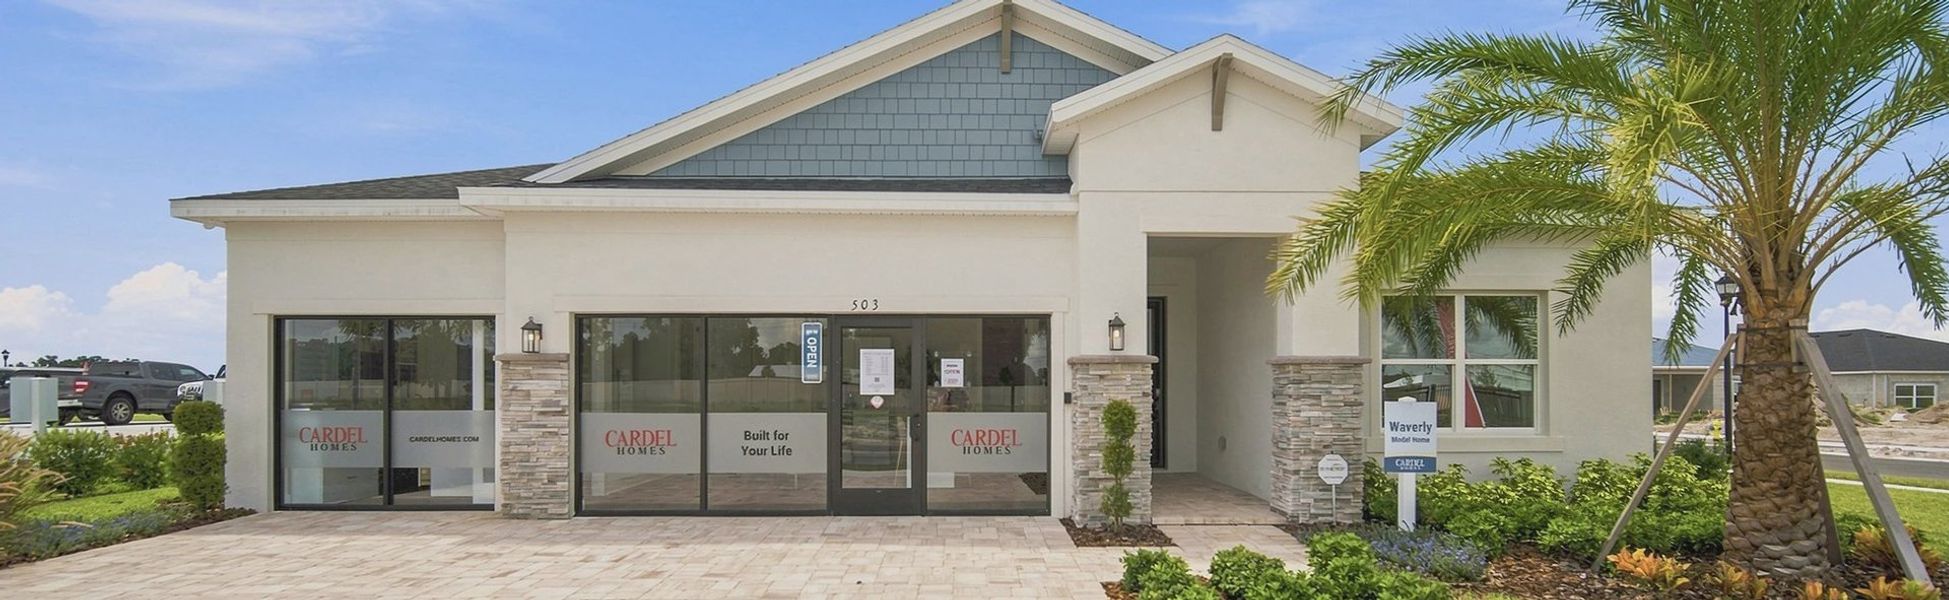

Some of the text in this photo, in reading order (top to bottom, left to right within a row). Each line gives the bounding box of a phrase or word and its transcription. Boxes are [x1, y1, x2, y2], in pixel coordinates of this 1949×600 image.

[851, 299, 879, 311] 503
[806, 337, 818, 368] OPEN
[1389, 421, 1433, 435] Waverly
[299, 427, 368, 443] CARDEL
[605, 429, 678, 447] CARDEL
[743, 430, 790, 441] Built for
[951, 428, 1023, 446] CARDEL
[310, 443, 358, 451] HOMES
[616, 446, 667, 455] HOMES
[741, 445, 793, 456] Your Life
[963, 446, 1012, 455] HOMES
